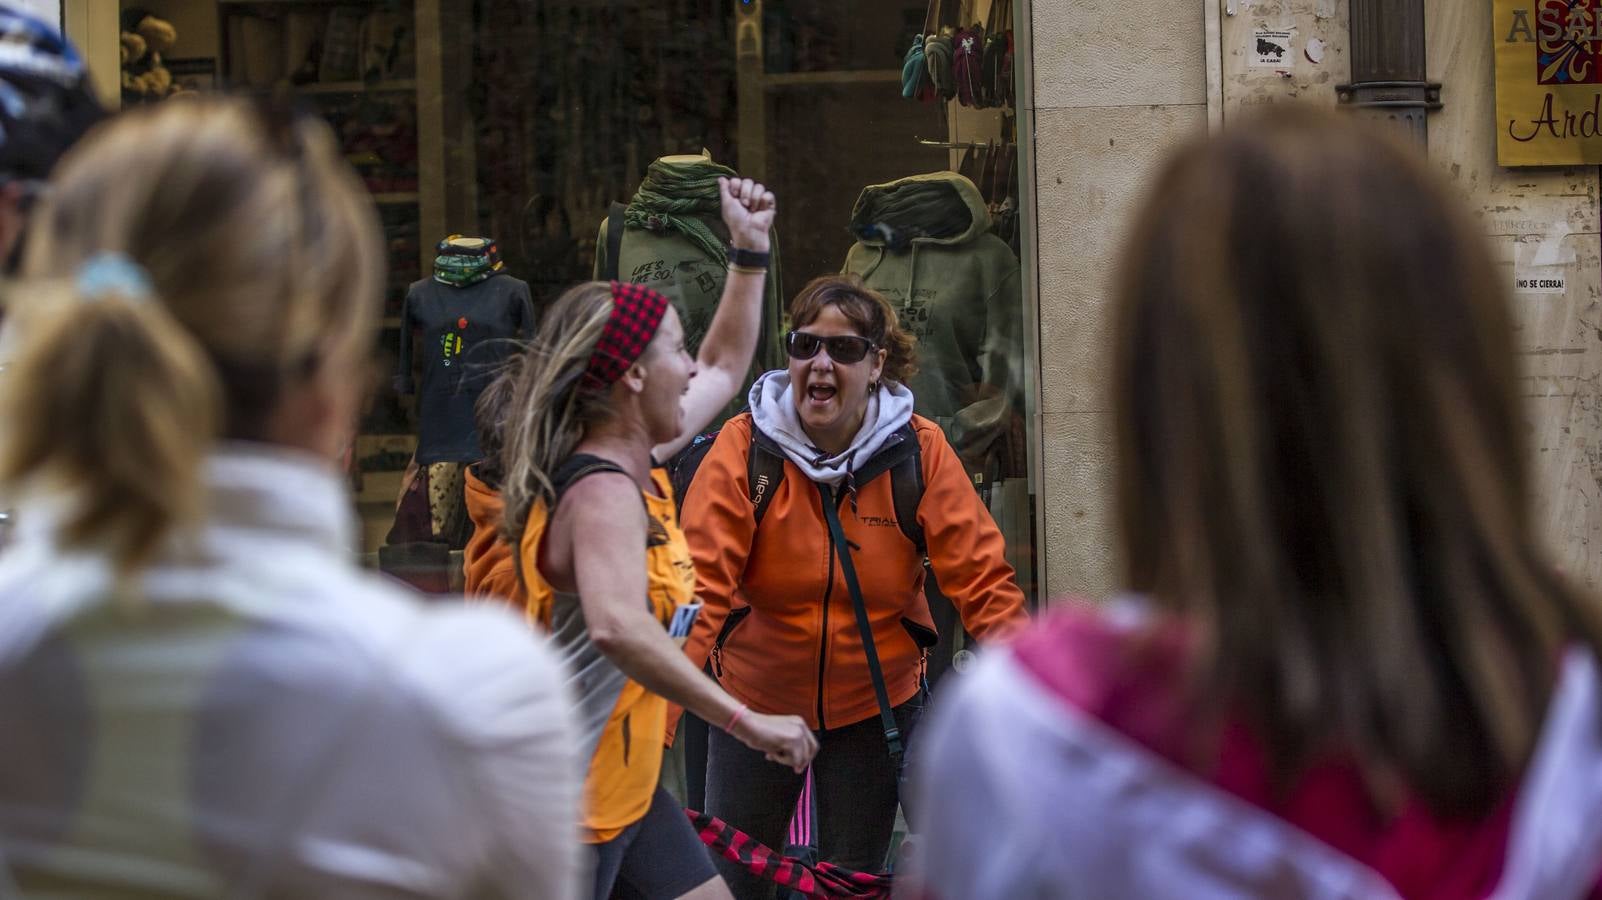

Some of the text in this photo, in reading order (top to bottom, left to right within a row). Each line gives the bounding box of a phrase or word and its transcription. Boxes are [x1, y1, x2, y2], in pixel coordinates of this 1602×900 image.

[653, 265, 677, 280] SO!
[1516, 280, 1564, 289] ¡NO SE CIERRA!
